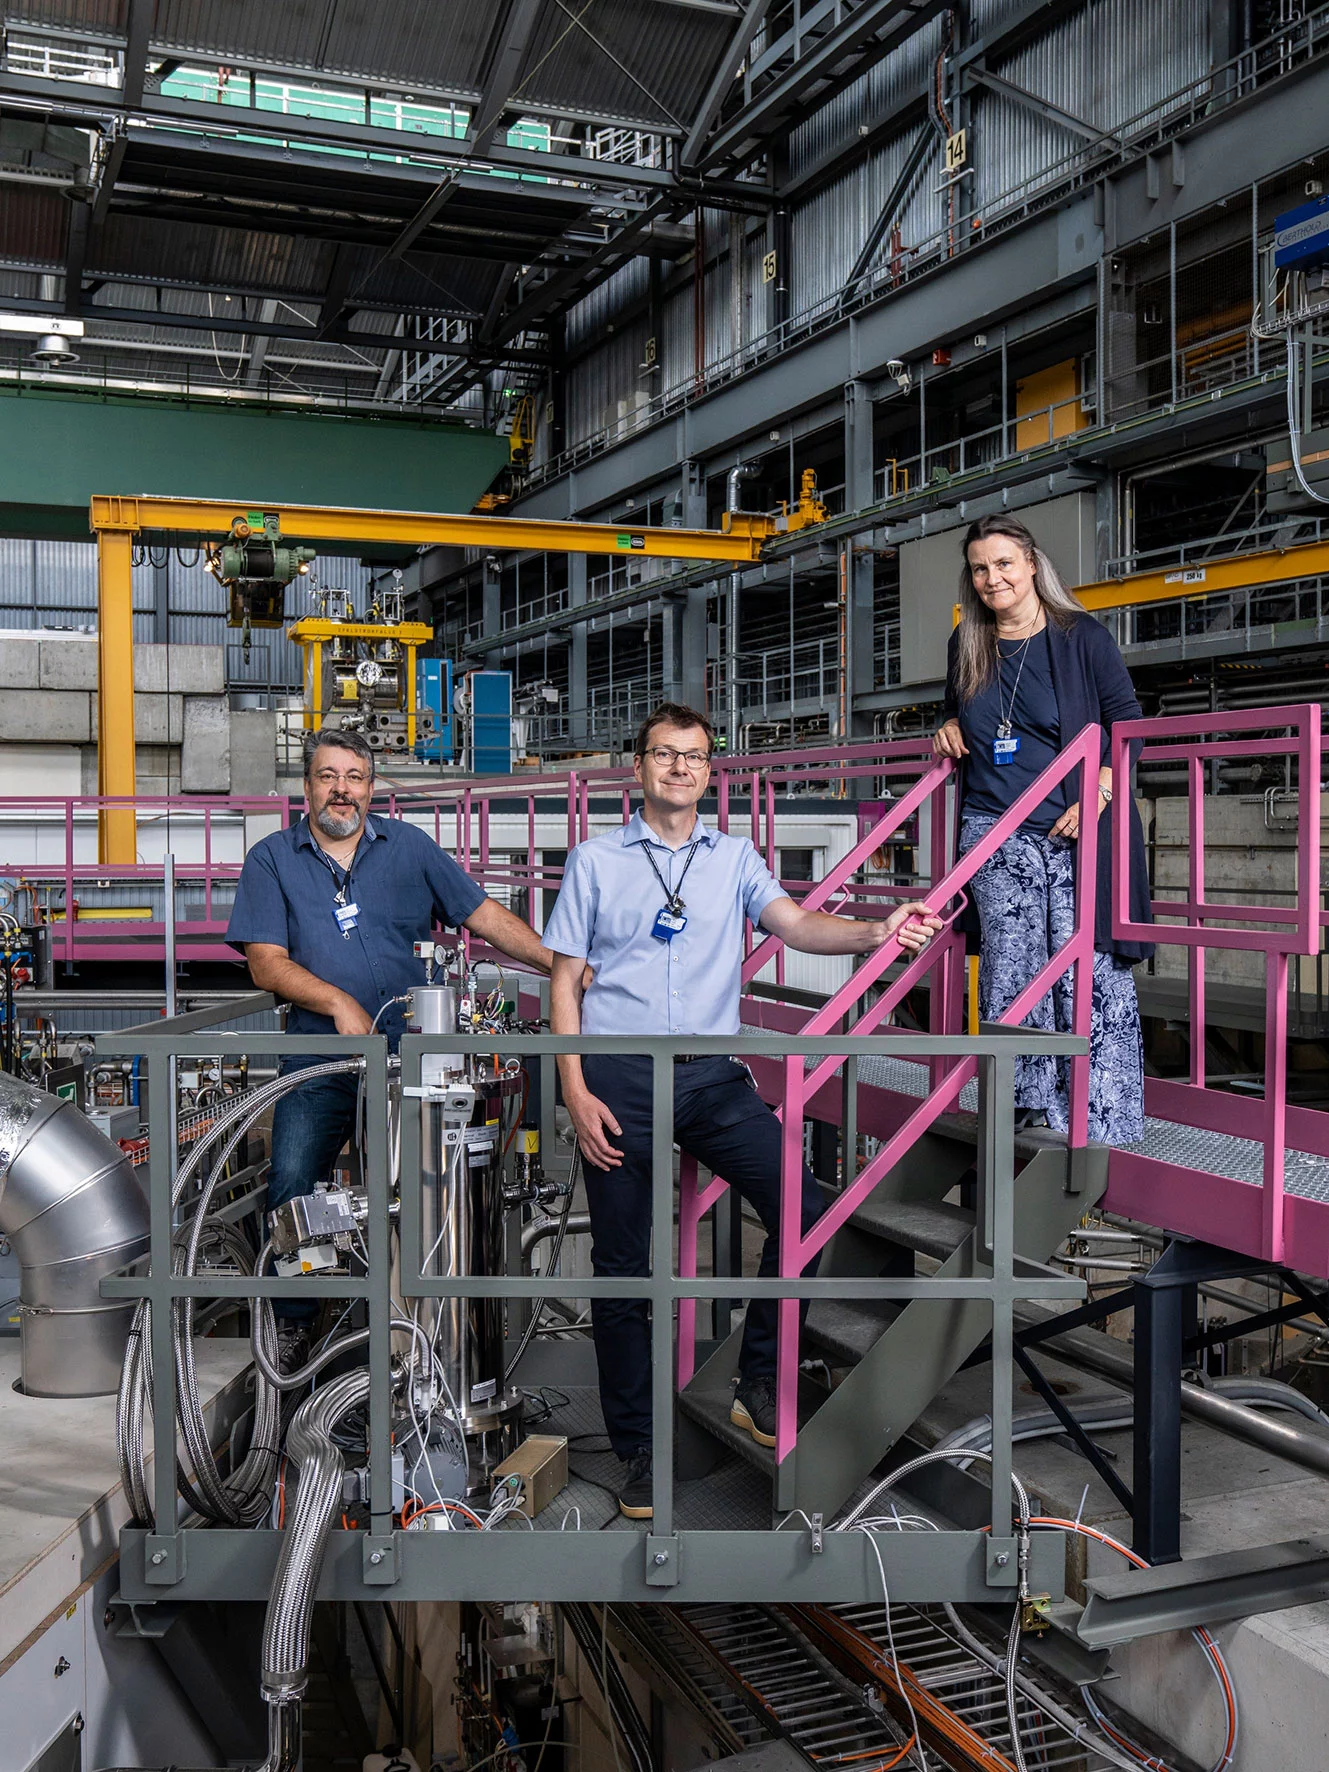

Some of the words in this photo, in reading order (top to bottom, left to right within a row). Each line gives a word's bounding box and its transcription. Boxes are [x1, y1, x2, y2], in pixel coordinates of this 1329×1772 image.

[947, 134, 964, 166] 14
[764, 254, 775, 280] 15
[646, 340, 655, 362] 16
